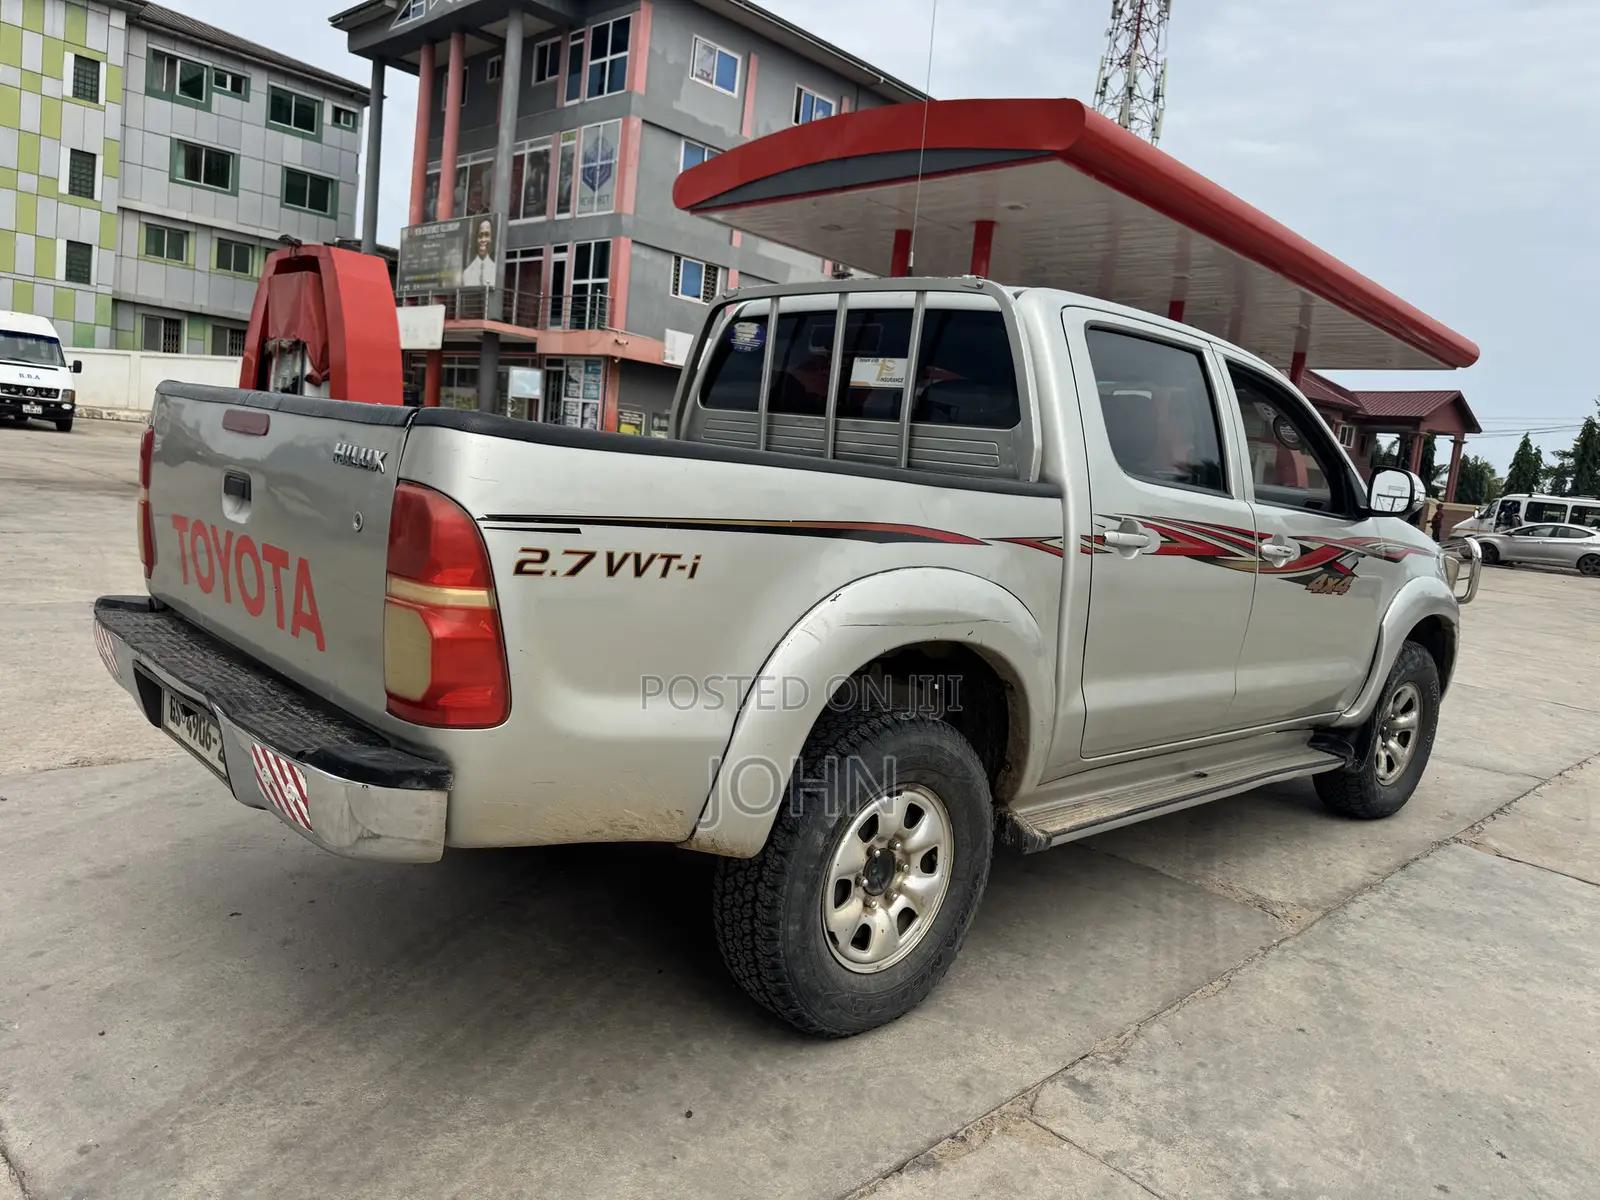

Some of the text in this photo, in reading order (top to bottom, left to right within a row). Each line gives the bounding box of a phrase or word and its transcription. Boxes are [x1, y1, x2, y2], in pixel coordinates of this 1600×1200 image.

[333, 442, 388, 474] HILUX
[513, 547, 703, 580] 2.7 VVT-i
[172, 514, 326, 652] TOYOTA
